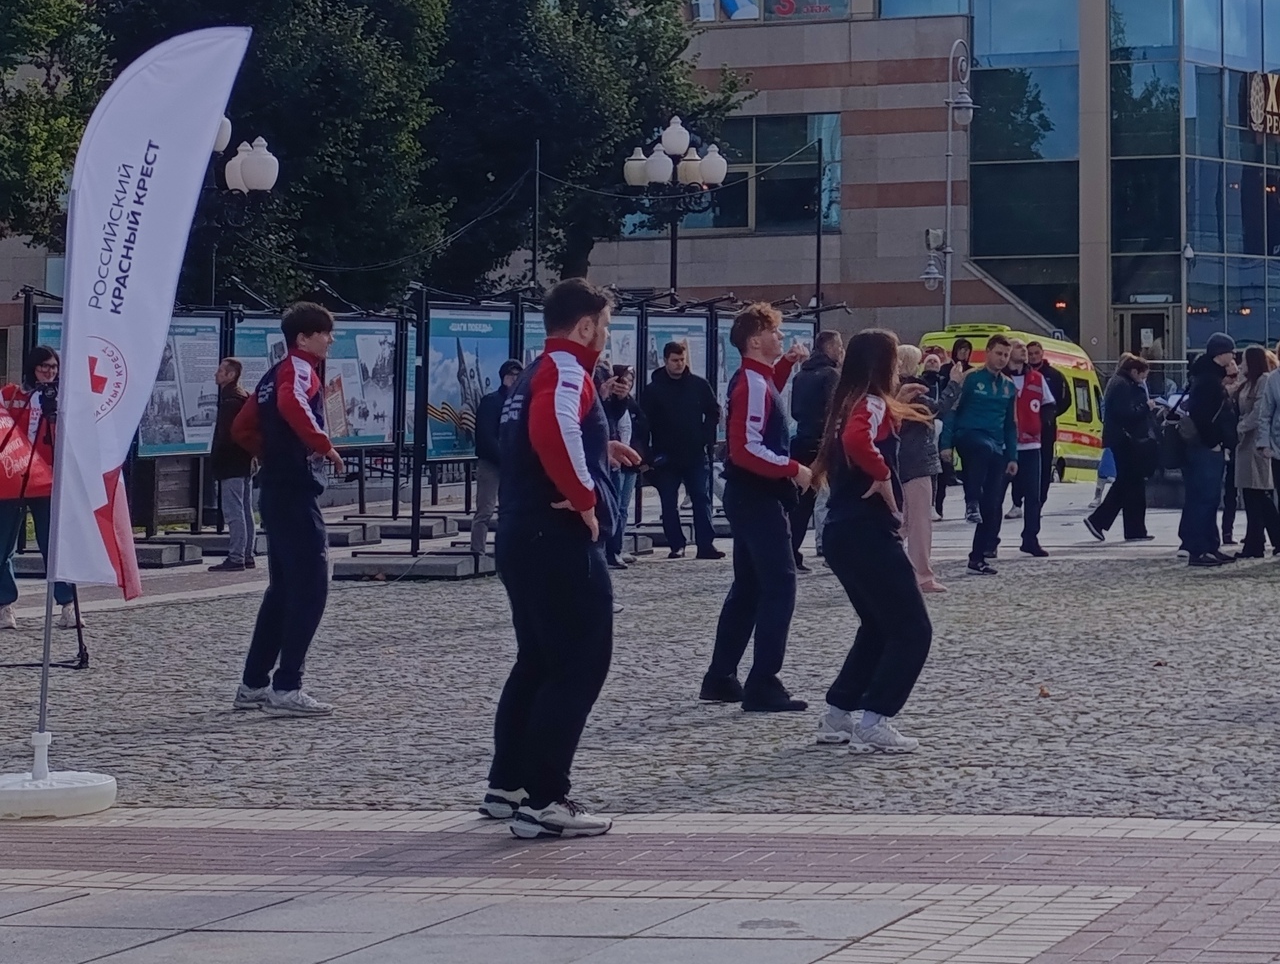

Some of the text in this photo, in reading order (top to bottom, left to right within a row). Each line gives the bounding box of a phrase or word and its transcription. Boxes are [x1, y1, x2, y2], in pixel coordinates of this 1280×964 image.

[88, 163, 134, 309] РОССИЙСКИЙ
[110, 139, 160, 315] КРАСНЫЙ КРЕСТ
[94, 346, 123, 417] АСНЫЙ КРЕСТ
